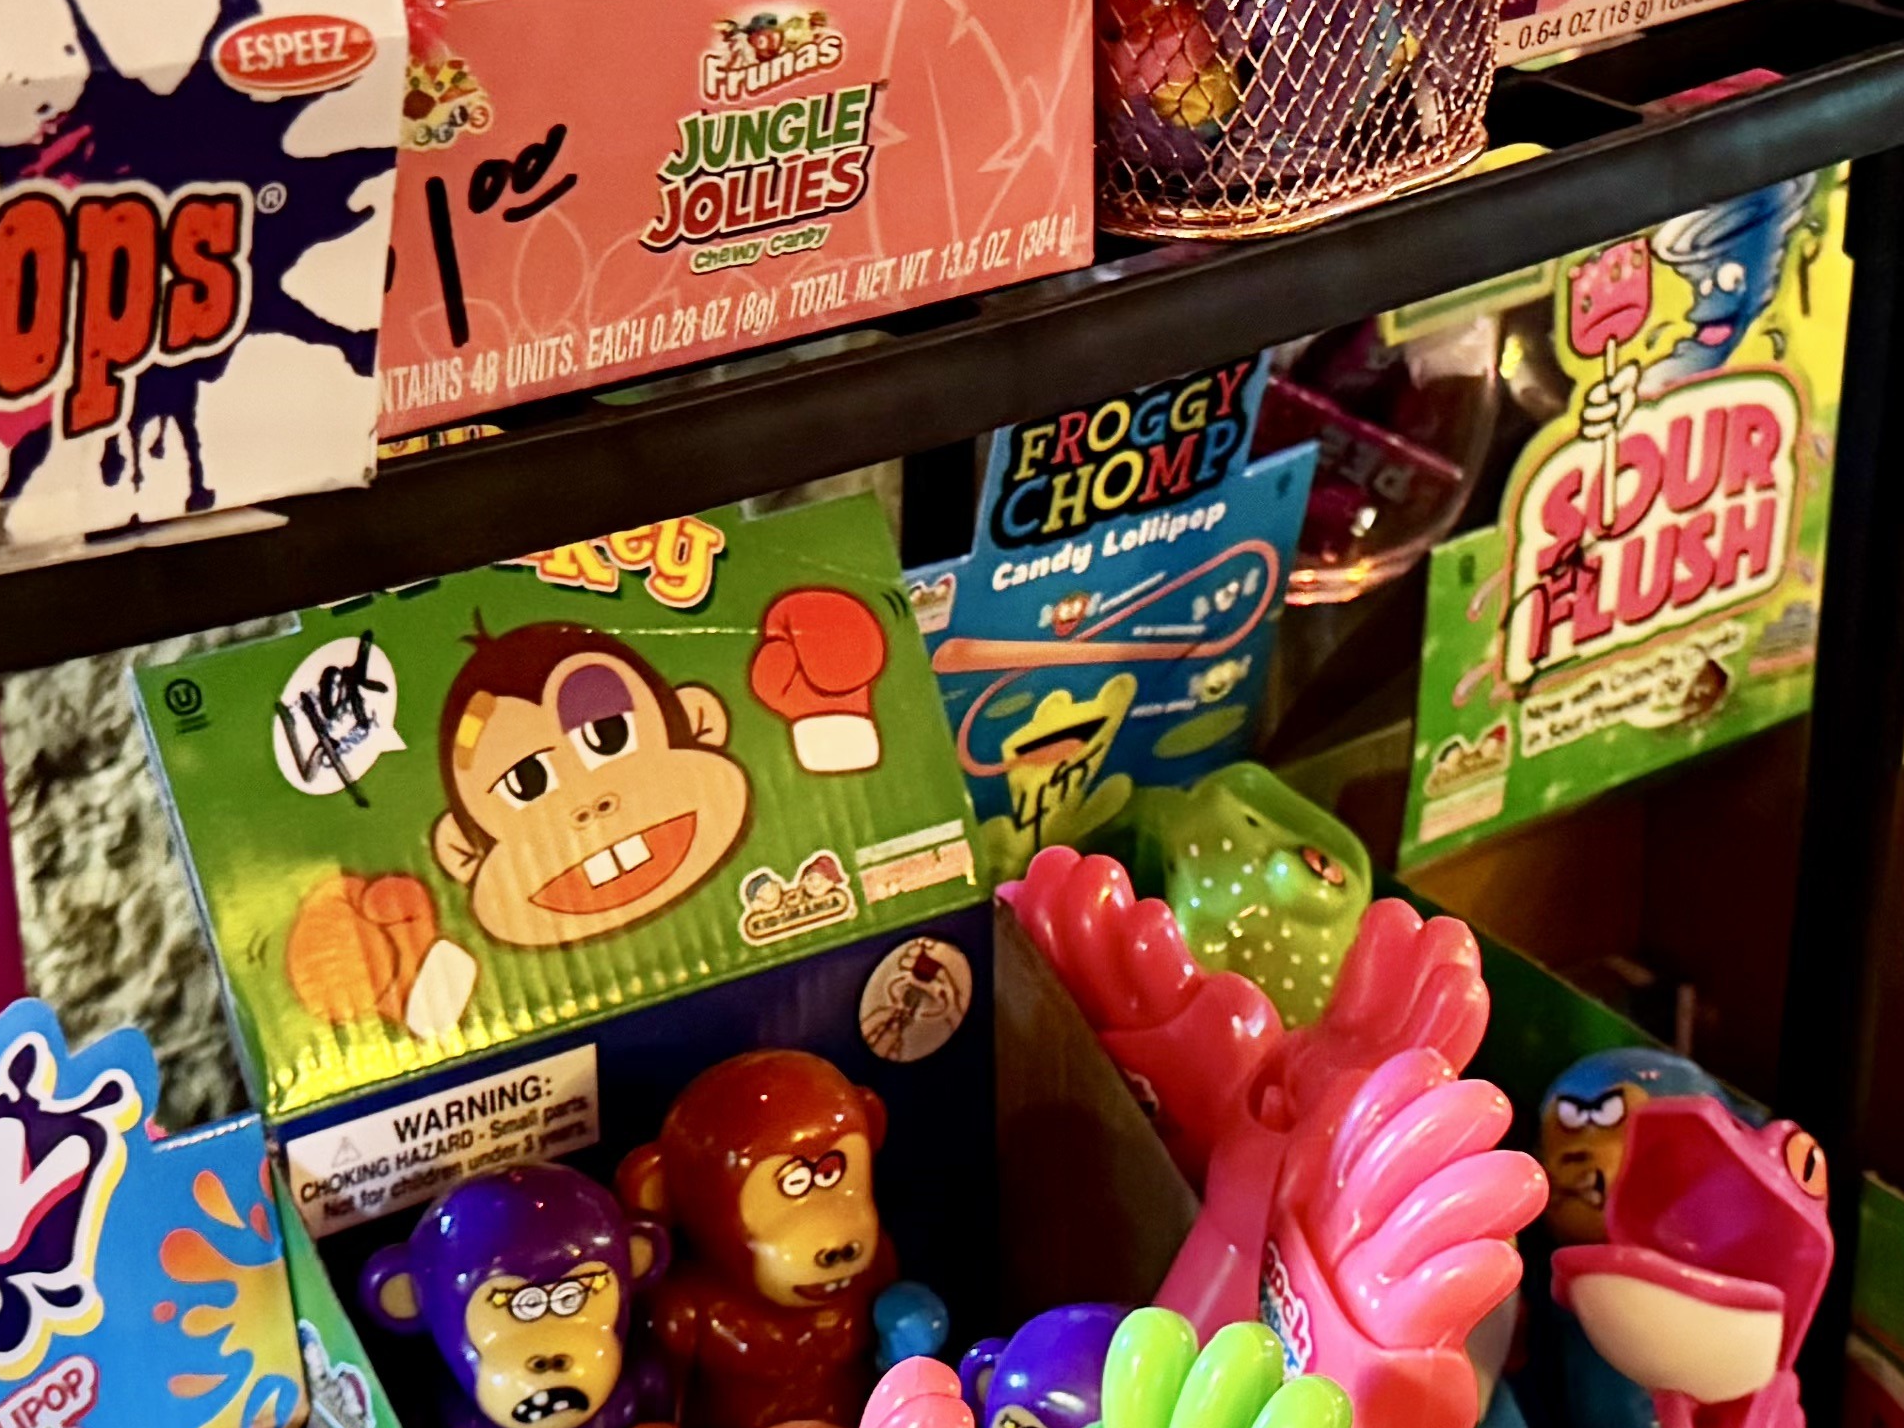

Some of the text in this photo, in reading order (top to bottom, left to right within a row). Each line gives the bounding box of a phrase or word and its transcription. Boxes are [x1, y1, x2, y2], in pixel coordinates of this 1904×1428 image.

[235, 24, 351, 73] ESPEEZ
[704, 29, 844, 101] Frunas
[1518, 16, 1565, 51] 0.64
[1567, 10, 1592, 39] OZ
[1599, 0, 1631, 36] (18
[661, 87, 876, 176] JUNGLE
[642, 146, 874, 251] JOLLIES
[376, 352, 465, 415] NTAINS
[505, 334, 581, 387] UNITS.
[587, 318, 644, 369] EACH
[649, 309, 695, 352] 0.28
[699, 299, 727, 338] OZ
[788, 267, 849, 317] TOTAL
[854, 257, 895, 302] NET
[937, 239, 981, 282] 13.5
[1017, 215, 1057, 272] (384
[1013, 361, 1253, 482] FROGGY
[1000, 418, 1241, 538] CHOMP
[1541, 402, 1783, 557] SOUR
[991, 500, 1227, 593] Candy Lollipop
[1527, 496, 1778, 664] FLUSH
[392, 1074, 553, 1145] WARNING:
[299, 1155, 390, 1204] CHOKING
[396, 1127, 475, 1173] HAZARD
[490, 1110, 539, 1140] Small
[360, 1186, 386, 1208] for
